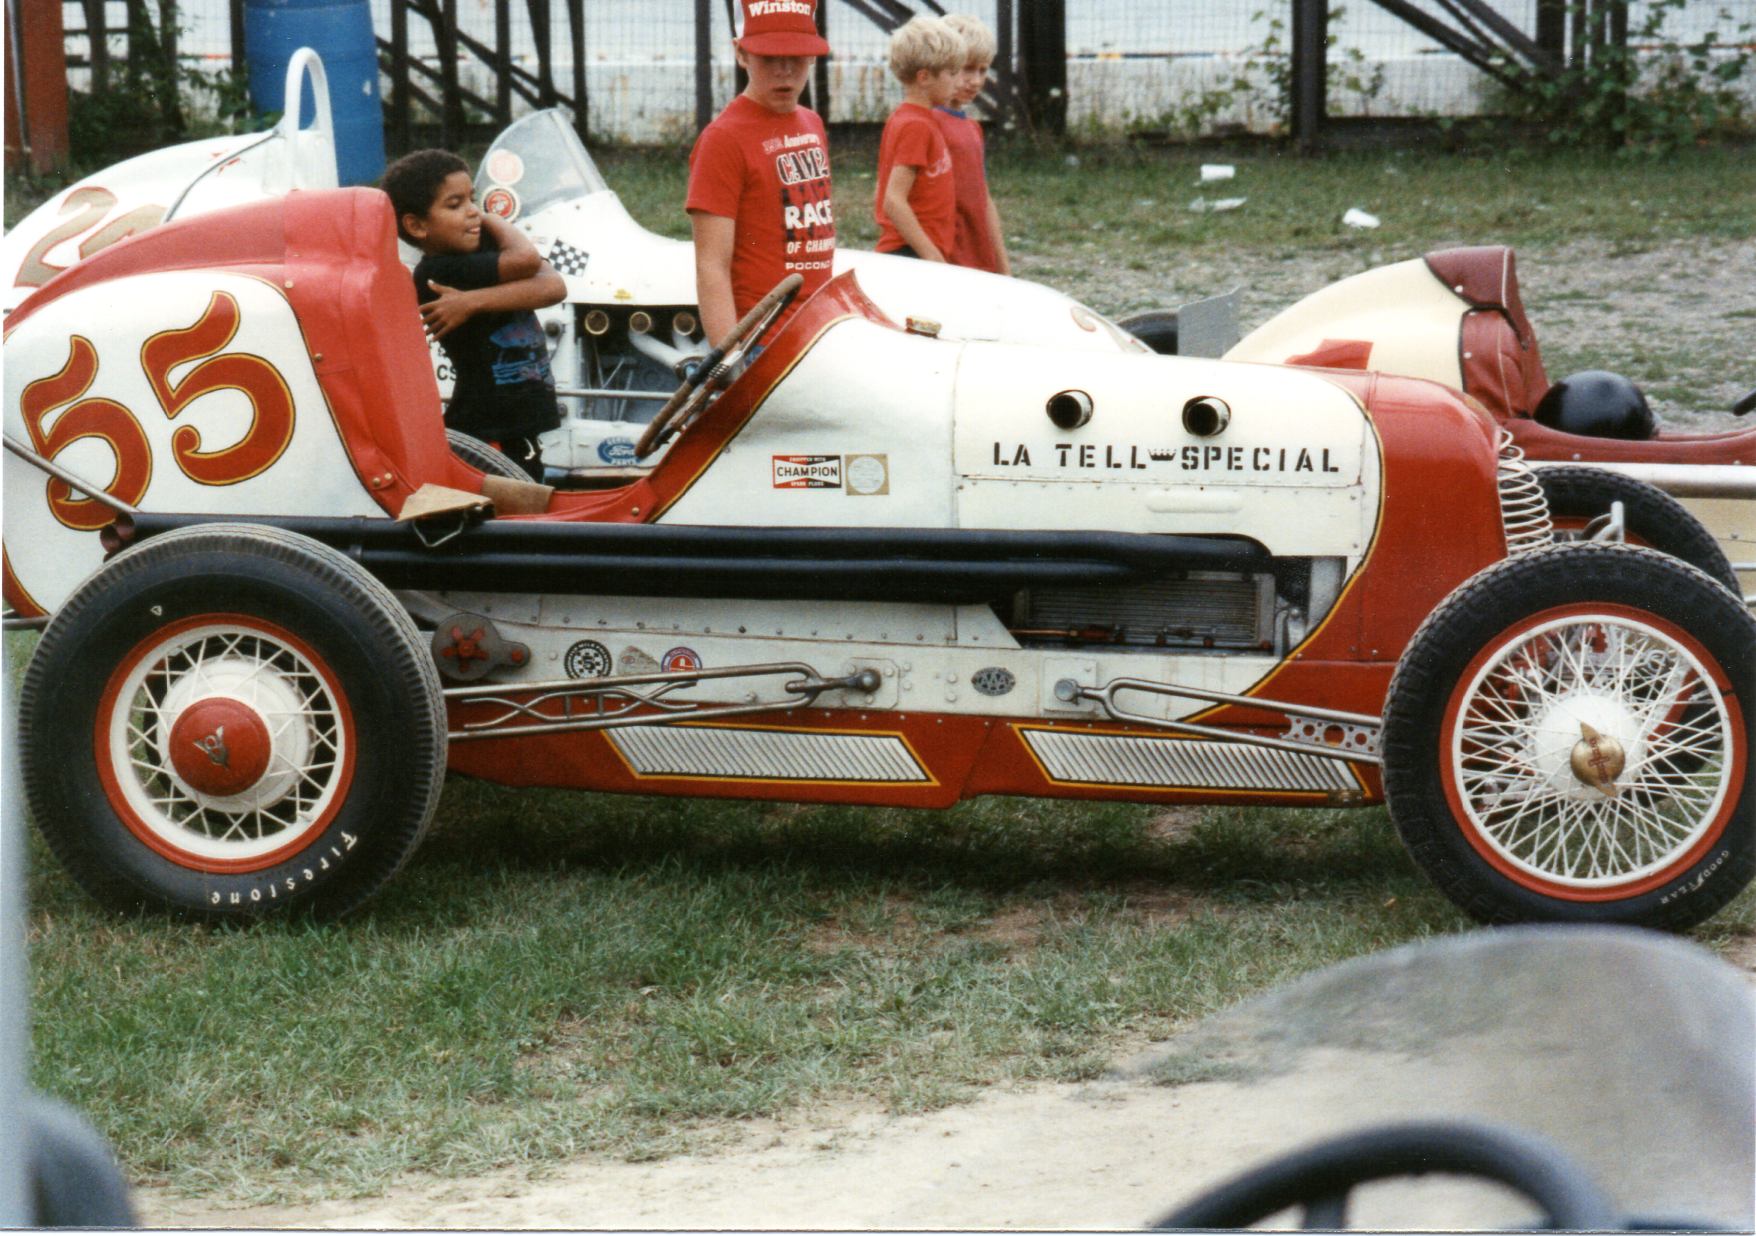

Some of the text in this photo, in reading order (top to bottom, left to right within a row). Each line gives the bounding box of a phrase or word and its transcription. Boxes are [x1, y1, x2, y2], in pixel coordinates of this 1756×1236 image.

[748, 1, 811, 17] Winston
[787, 240, 802, 254] OF
[20, 291, 295, 532] 55
[776, 466, 838, 477] CHAMPION
[993, 442, 1340, 473] LA TELL SPECIAL
[211, 831, 358, 904] Firestone
[1661, 850, 1729, 904] GOODYEAR
